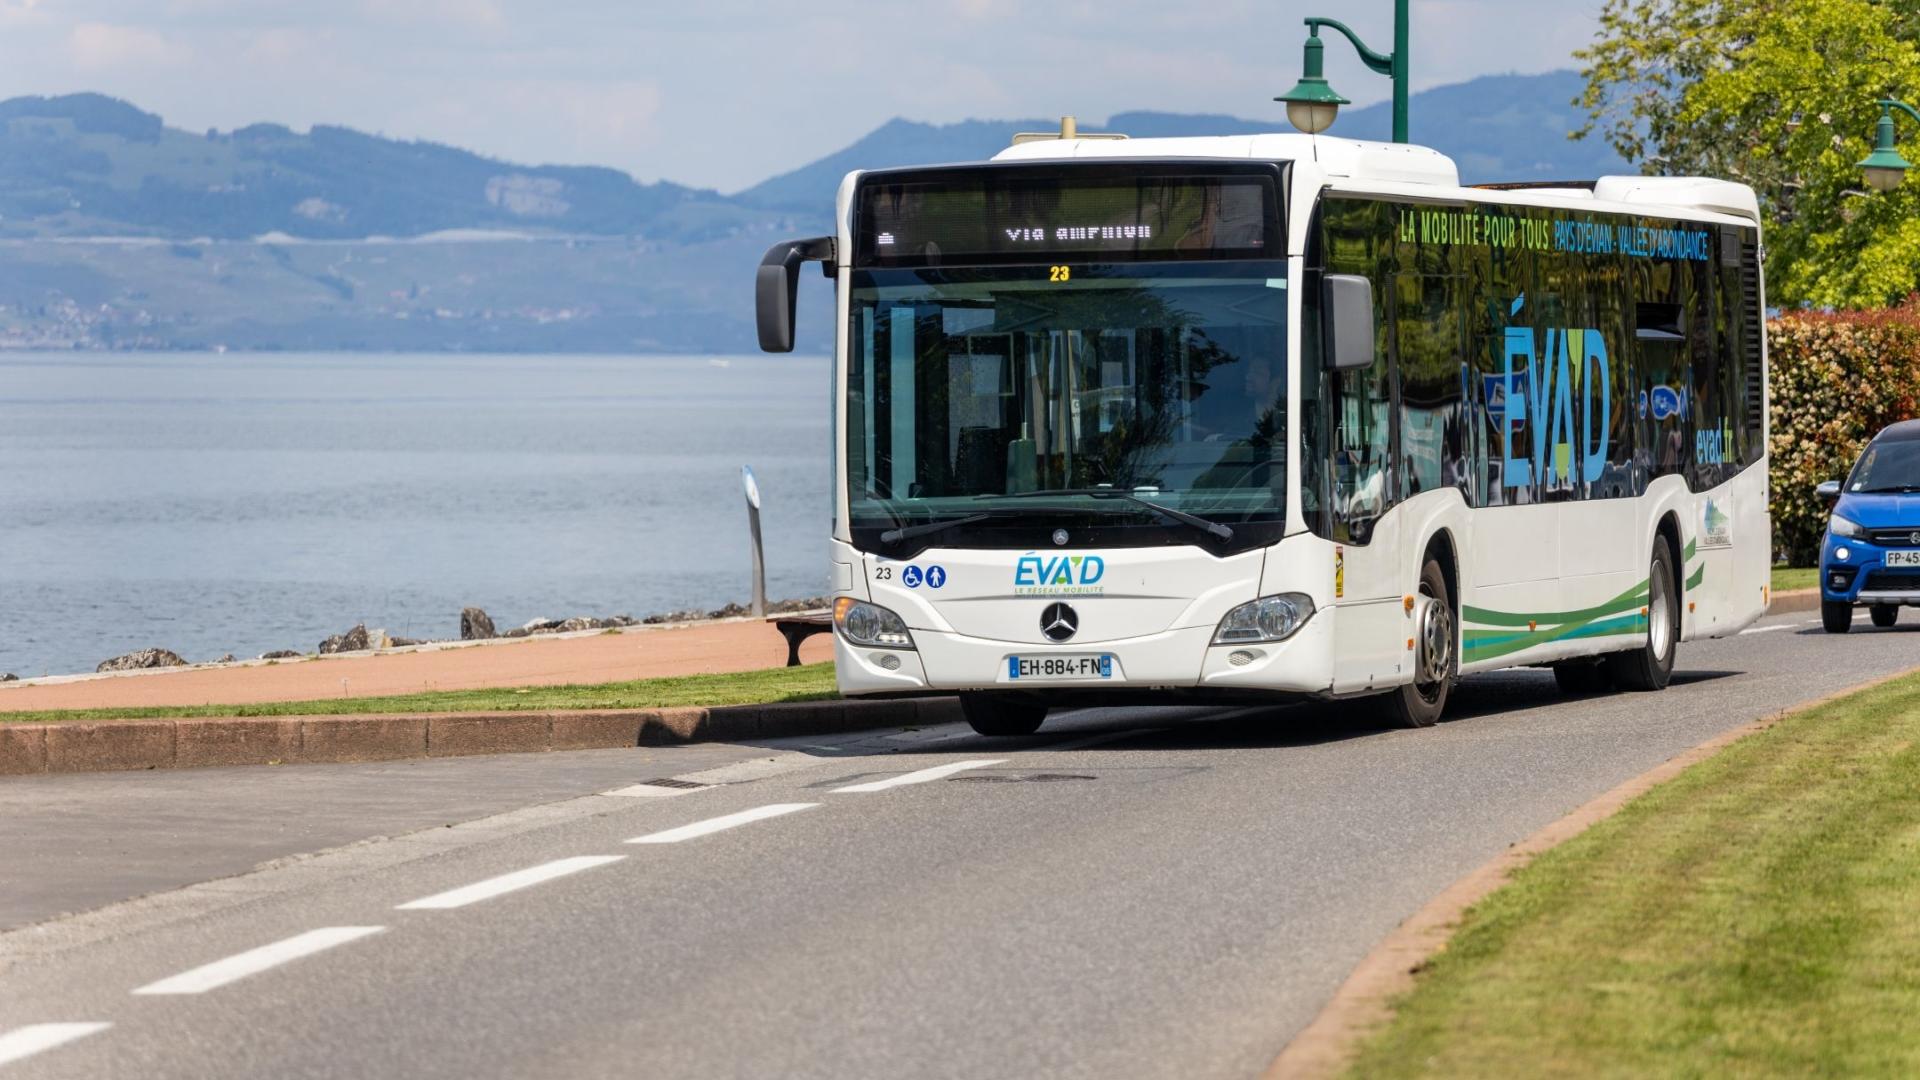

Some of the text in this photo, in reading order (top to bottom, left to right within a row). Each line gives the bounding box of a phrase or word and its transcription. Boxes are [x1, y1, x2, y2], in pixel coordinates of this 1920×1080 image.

[1401, 210, 1416, 243] LA
[1421, 208, 1479, 246] MOBILITÉ
[1484, 215, 1516, 248] POUR
[1520, 218, 1549, 250] TOUS
[1554, 220, 1575, 252] PAYS
[1618, 220, 1648, 256] VALLÉE
[1650, 229, 1708, 260] D'ABONDANCE
[1050, 265, 1070, 281] 23
[1696, 416, 1733, 464] evad.fr
[1888, 552, 1920, 564] FP-45
[876, 567, 891, 580] 23
[1020, 659, 1101, 675] EH-884-FN
